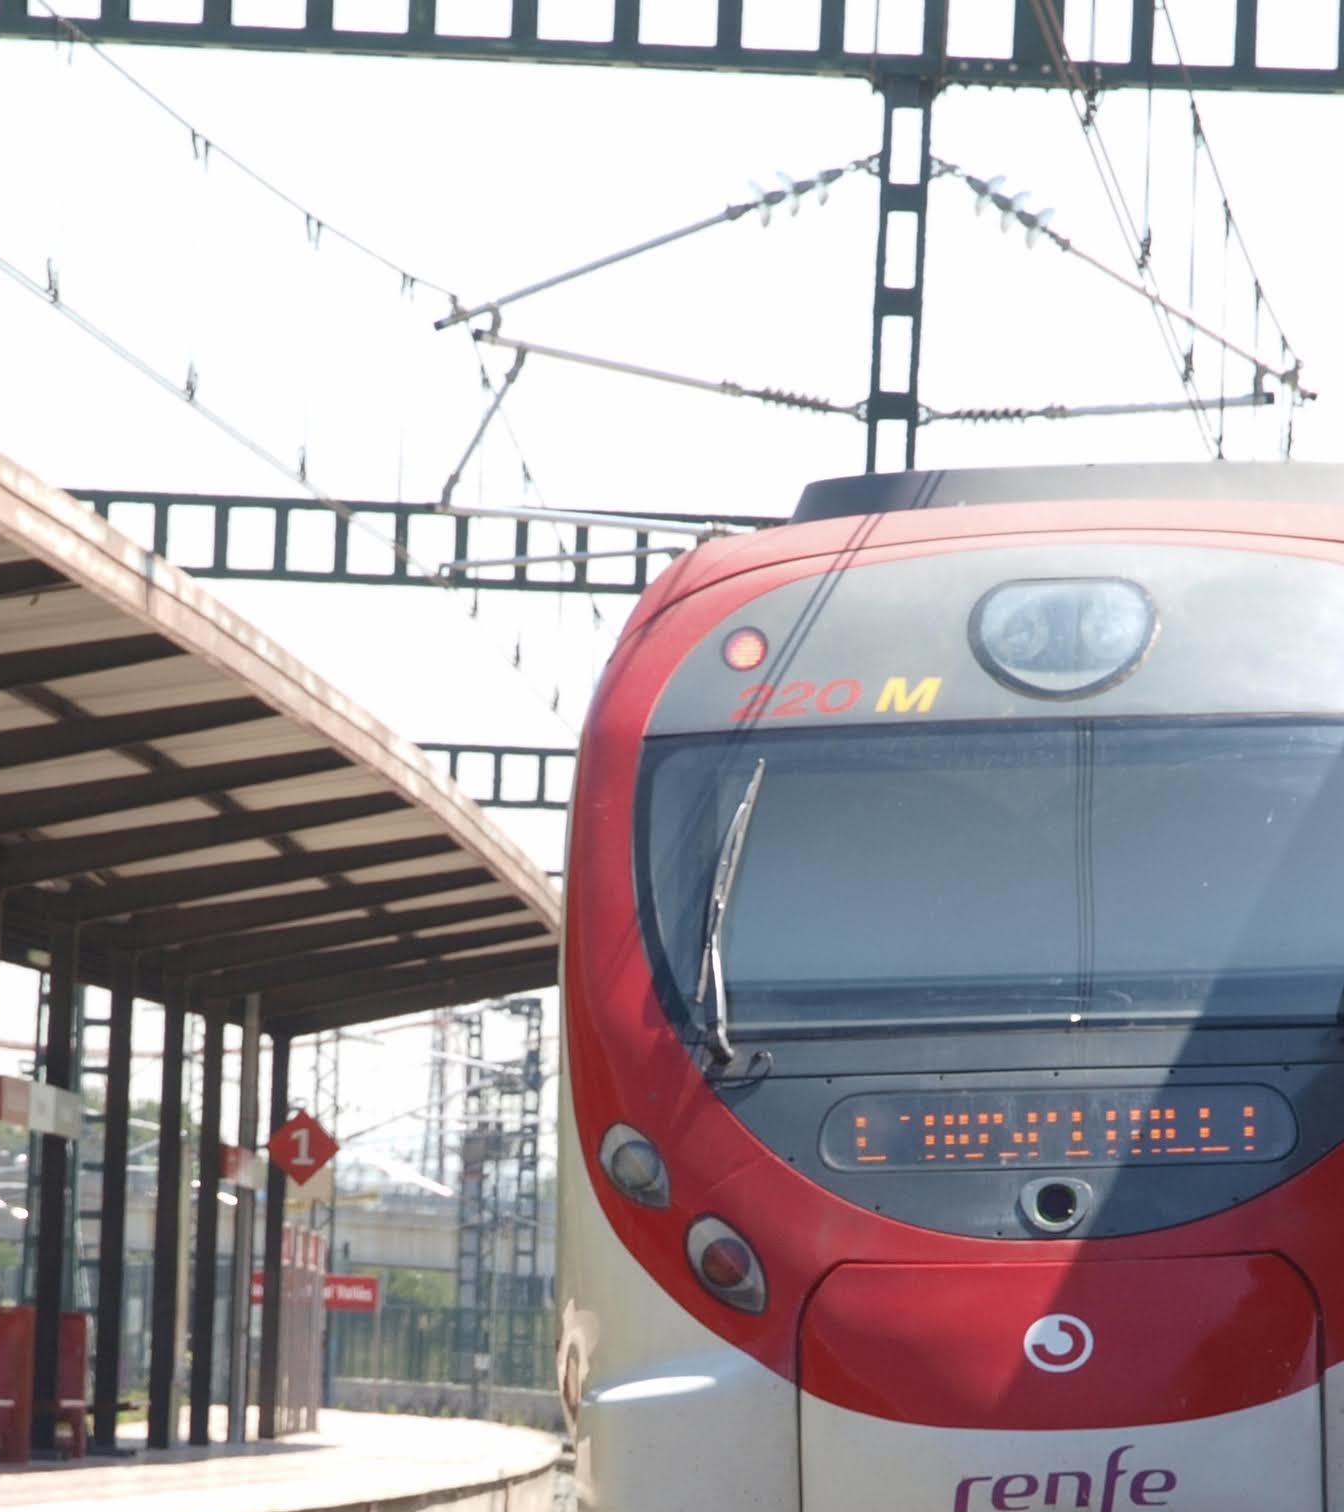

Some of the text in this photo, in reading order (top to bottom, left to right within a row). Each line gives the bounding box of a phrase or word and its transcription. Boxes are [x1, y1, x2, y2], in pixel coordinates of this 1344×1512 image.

[729, 676, 943, 722] 220 M
[291, 1128, 315, 1165] 1
